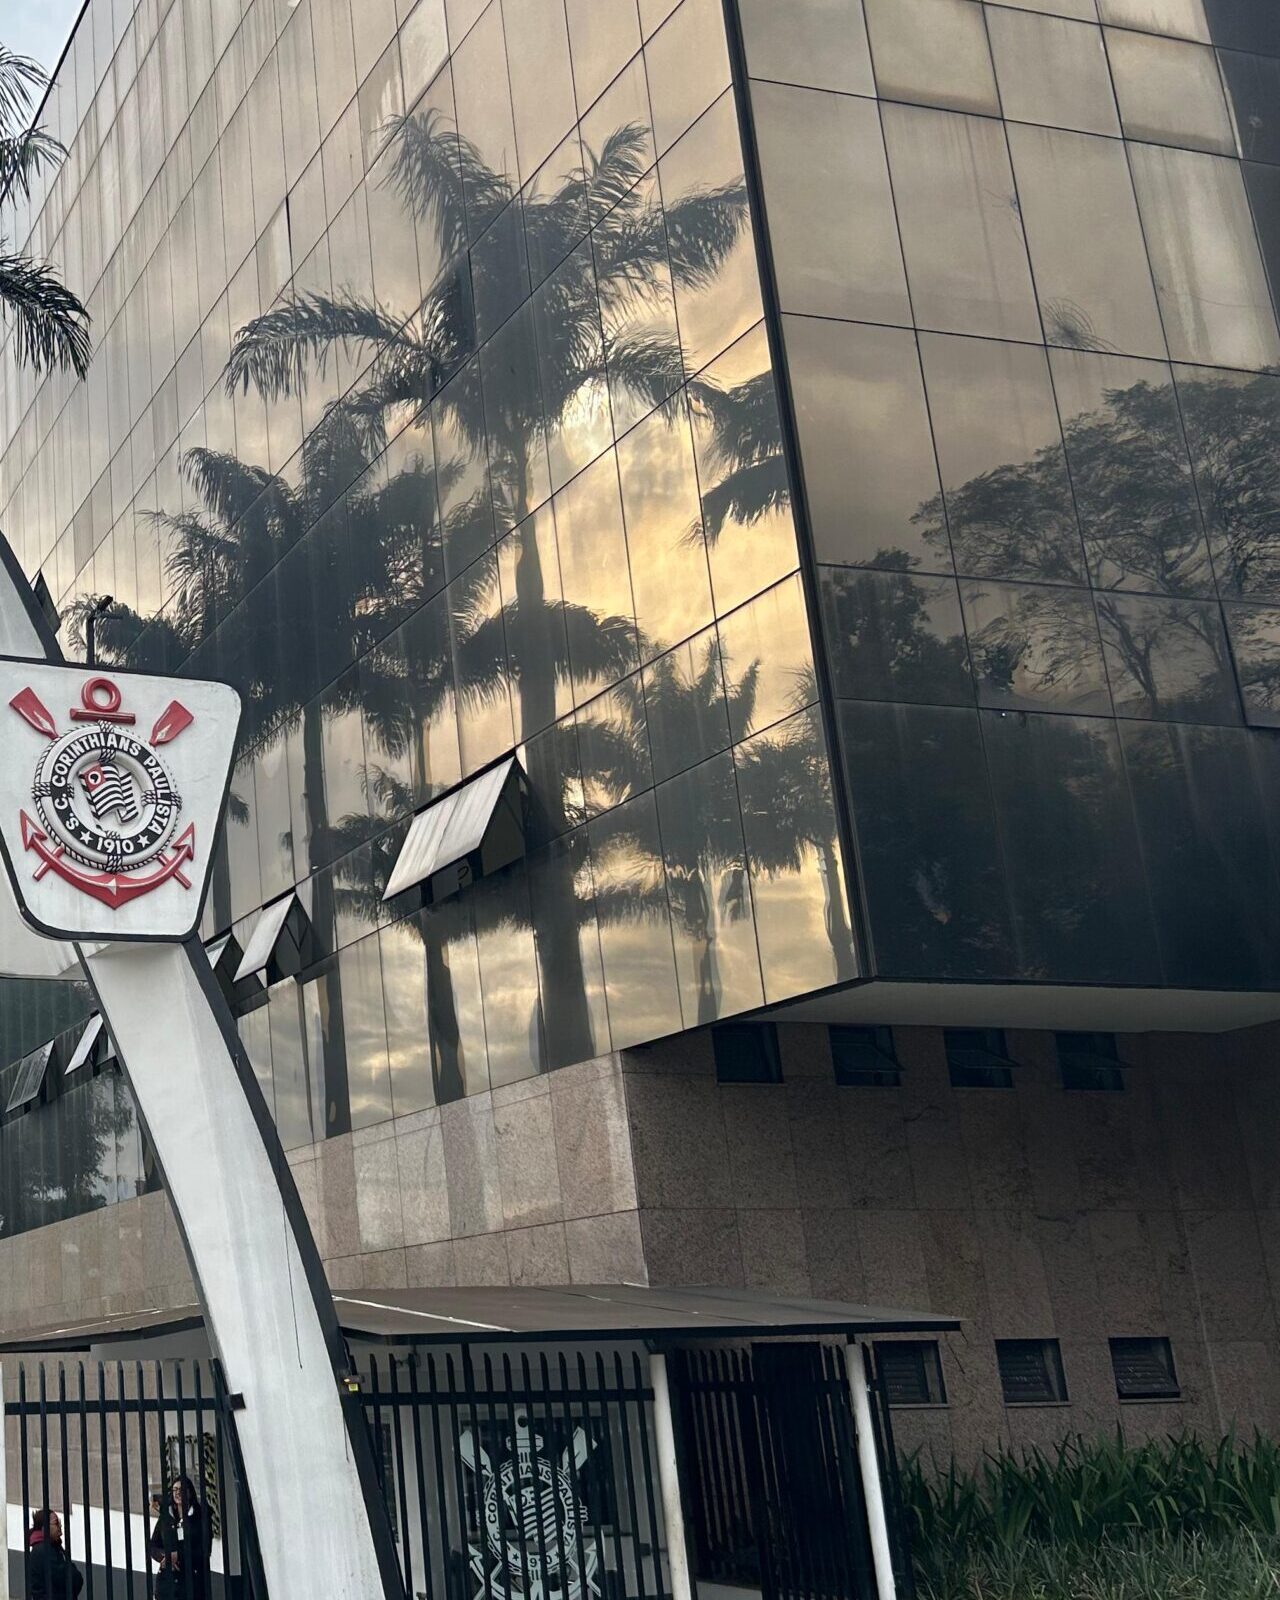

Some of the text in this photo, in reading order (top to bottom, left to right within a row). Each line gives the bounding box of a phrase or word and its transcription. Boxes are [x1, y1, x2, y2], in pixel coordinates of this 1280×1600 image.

[51, 733, 141, 787] CORINTHIANS
[54, 793, 68, 810] C.
[143, 755, 172, 835] PAULISTA
[96, 837, 135, 854] 1910
